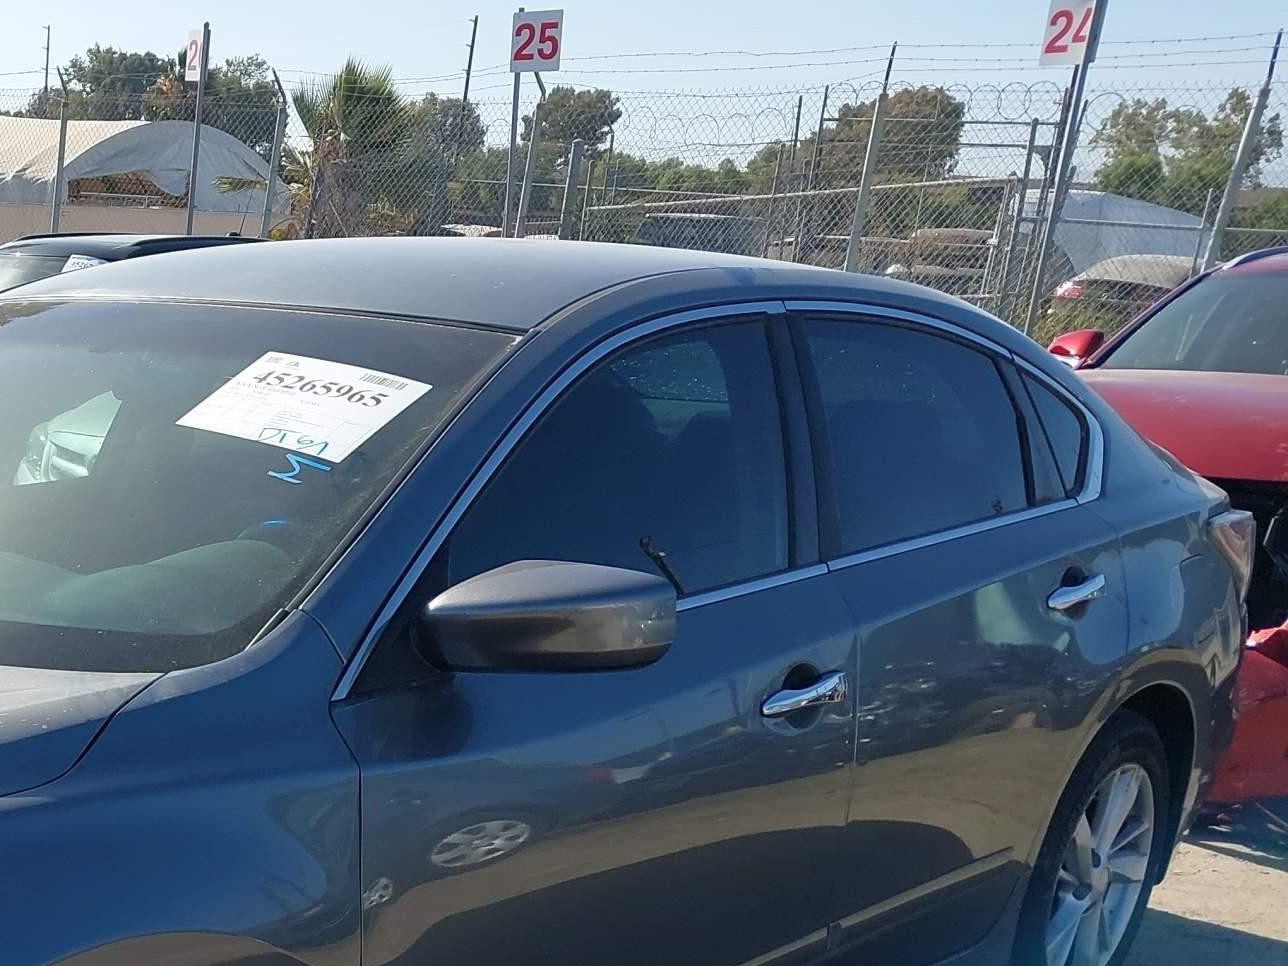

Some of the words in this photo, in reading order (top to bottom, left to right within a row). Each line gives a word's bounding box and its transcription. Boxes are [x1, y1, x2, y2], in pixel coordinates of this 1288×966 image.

[187, 40, 202, 70] 2
[513, 22, 559, 61] 25
[253, 370, 389, 407] 45265965
